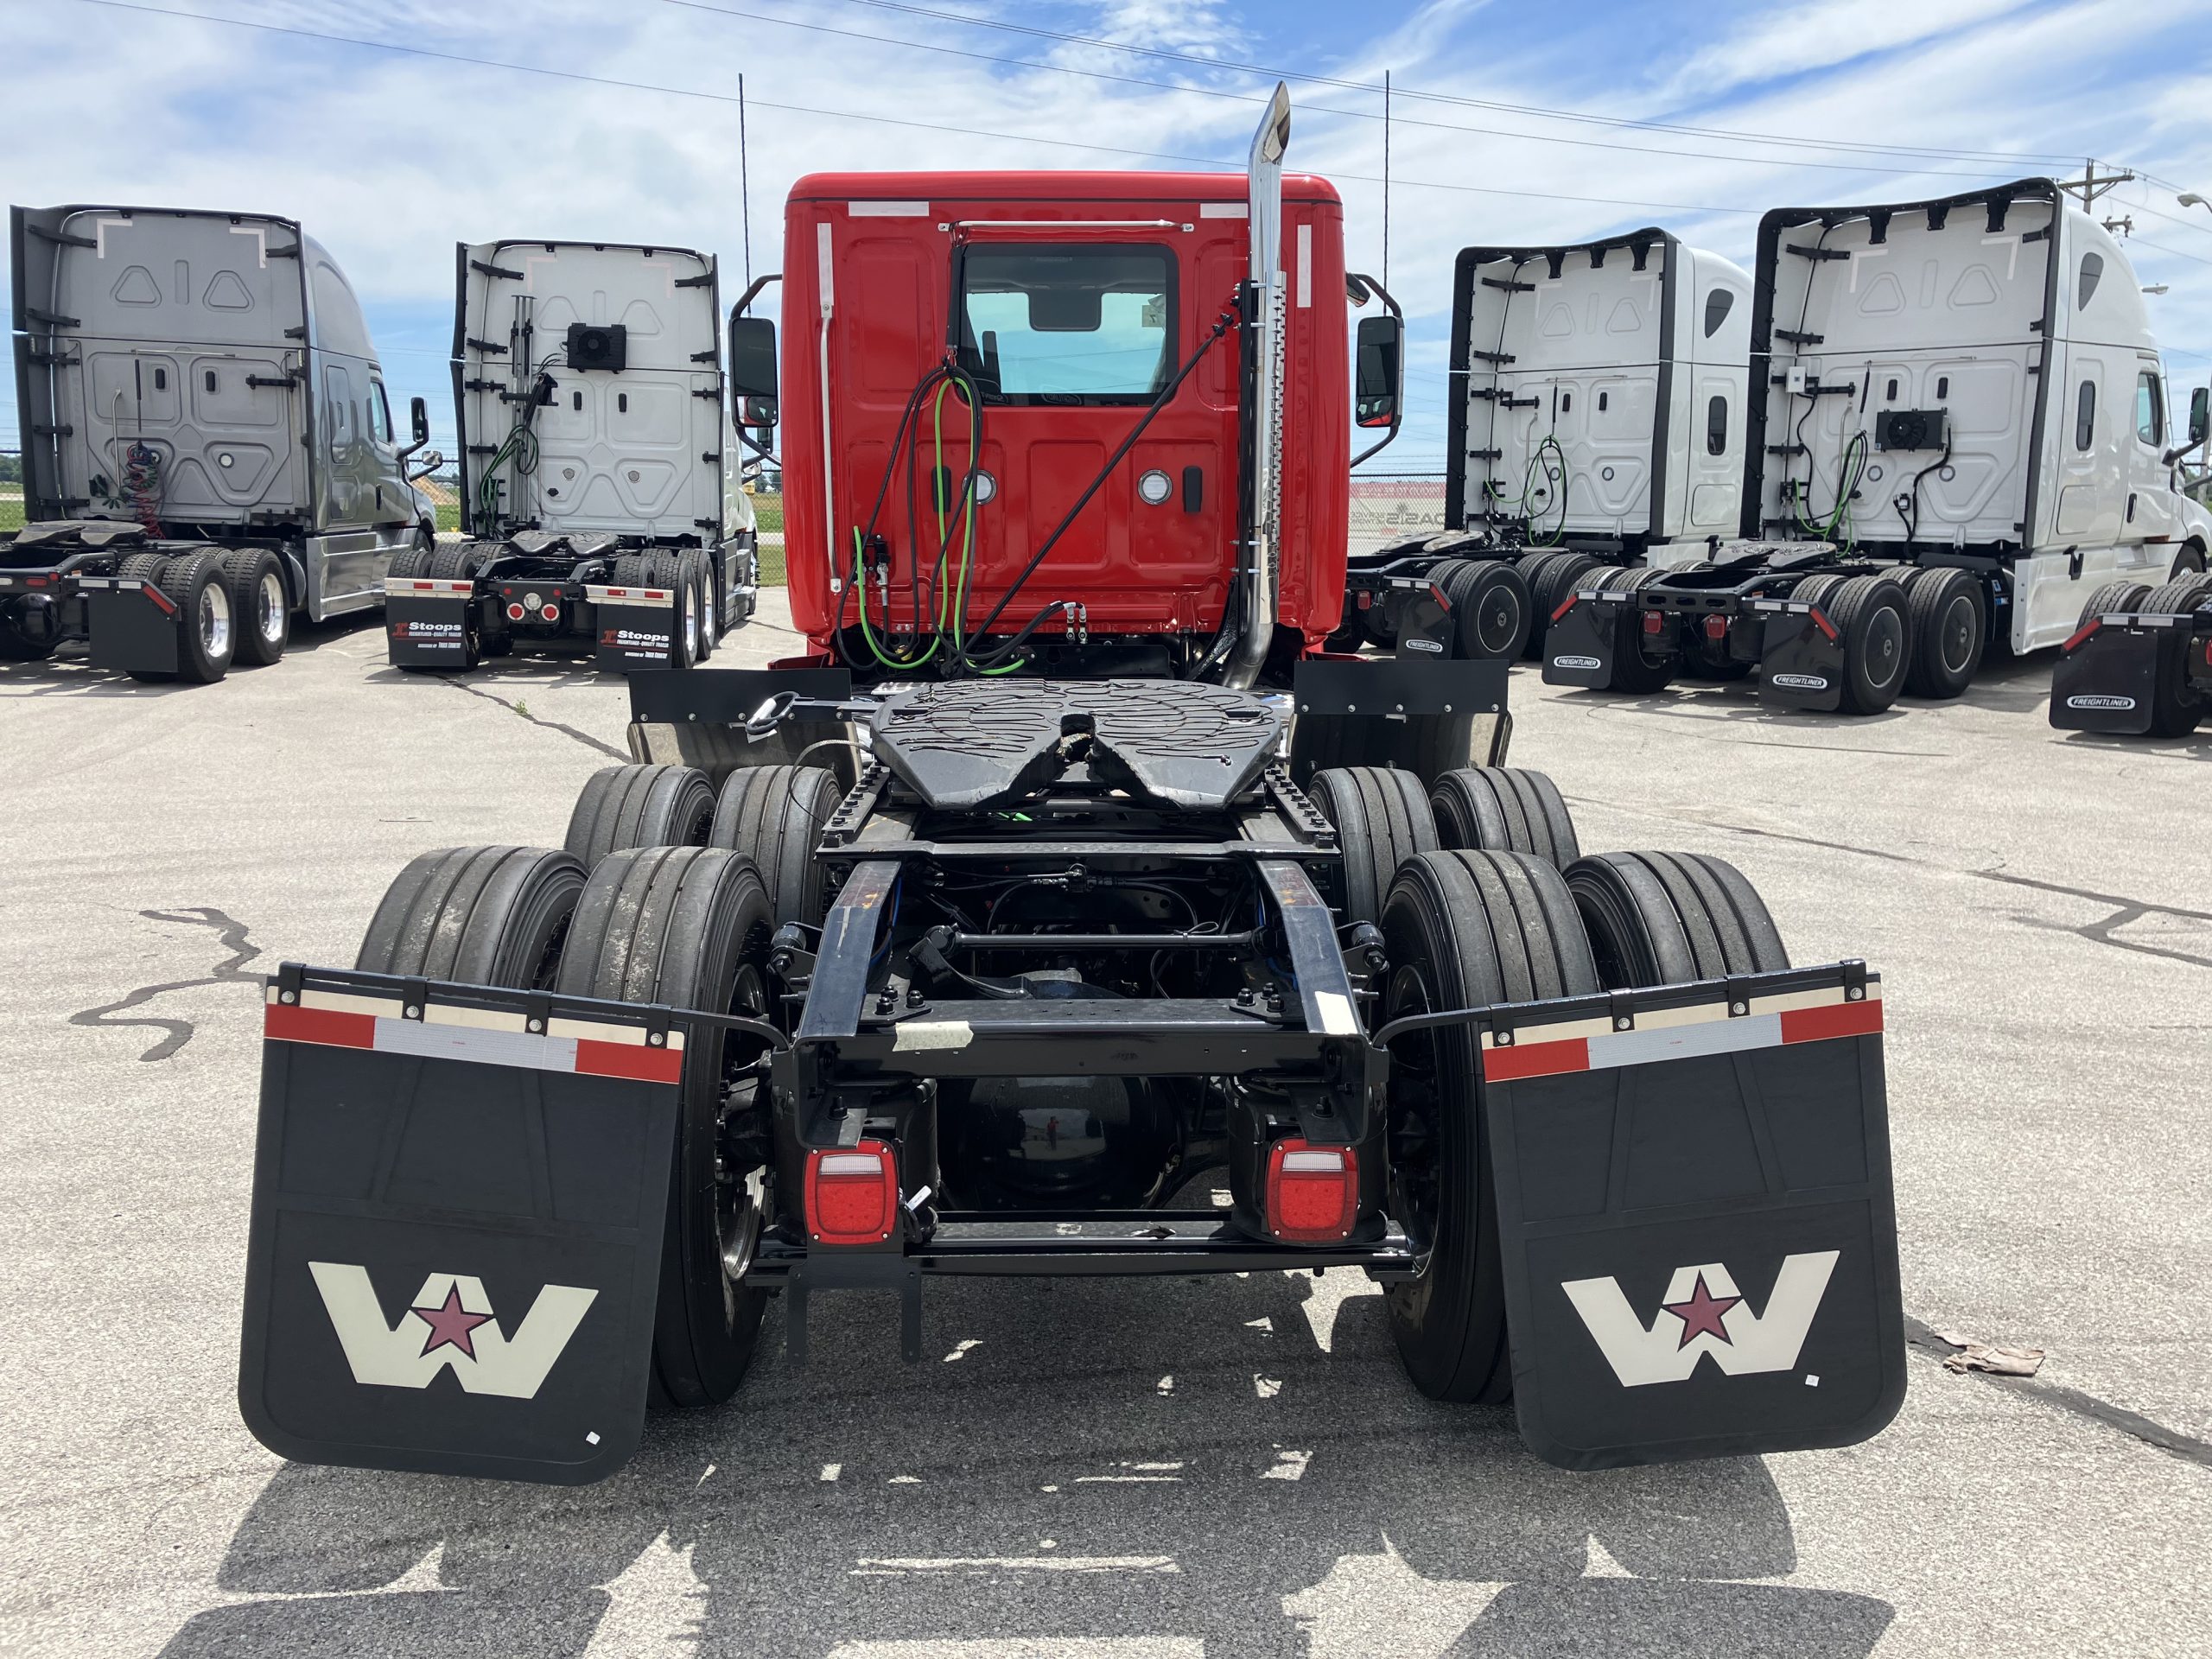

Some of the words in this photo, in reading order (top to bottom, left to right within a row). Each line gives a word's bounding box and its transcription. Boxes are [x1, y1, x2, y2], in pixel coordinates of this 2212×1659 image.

[409, 622, 461, 632] Stoops
[618, 630, 669, 641] Stoops
[1409, 641, 1440, 650] FREIGHTLINER
[1558, 658, 1597, 666] FREIGHTLINER
[1777, 677, 1822, 686] FREIGHTLINER
[2074, 697, 2130, 707] FREIGHTLINER
